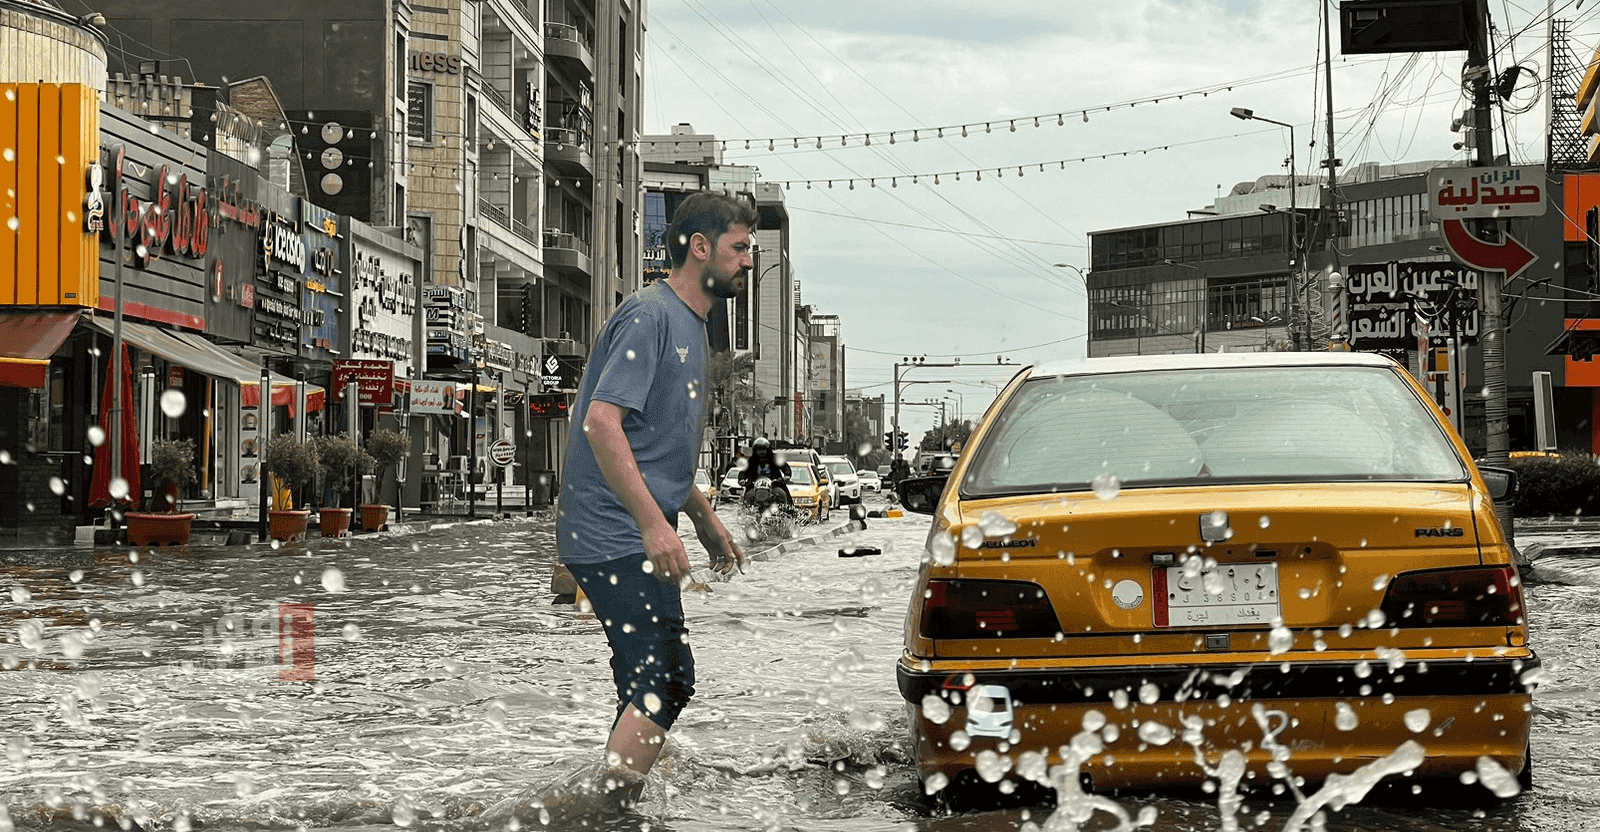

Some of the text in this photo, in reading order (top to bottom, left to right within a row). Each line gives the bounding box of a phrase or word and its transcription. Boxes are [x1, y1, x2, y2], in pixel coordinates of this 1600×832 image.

[1480, 169, 1520, 184] الزان
[1438, 177, 1540, 212] صيدلية
[1348, 262, 1398, 302] العرب
[1349, 307, 1406, 347] الشعر
[1415, 527, 1463, 538] PARS
